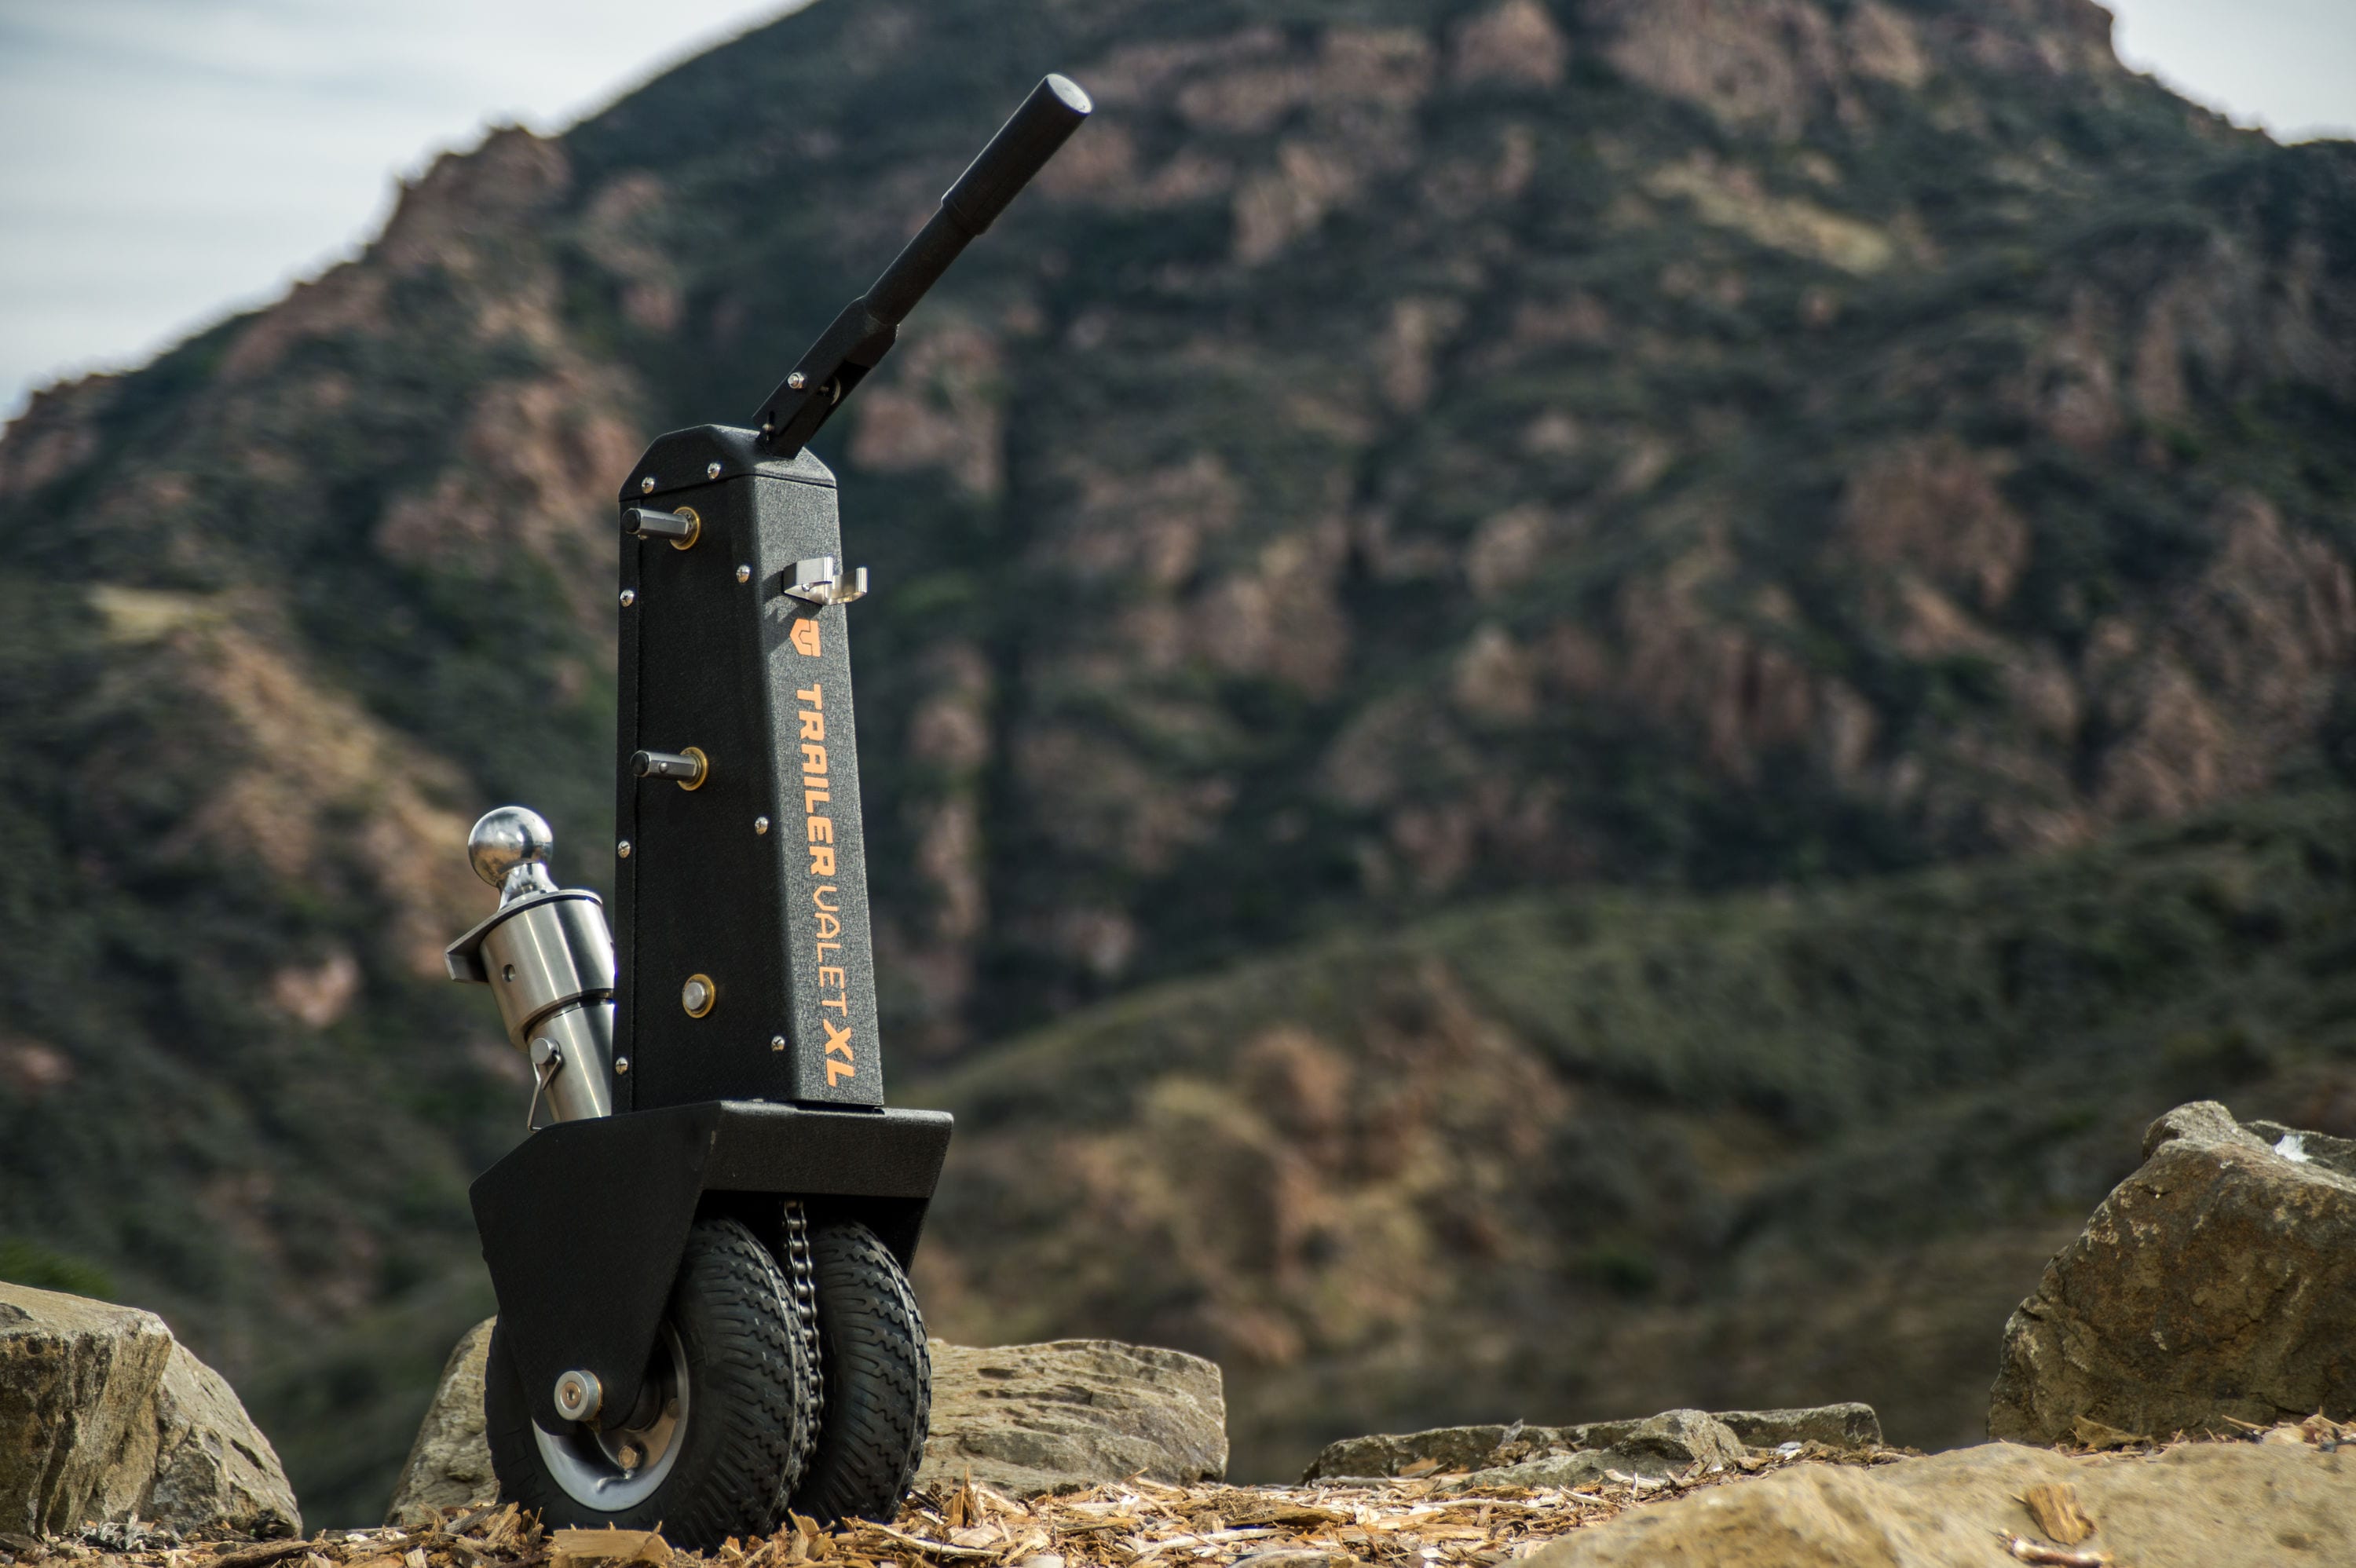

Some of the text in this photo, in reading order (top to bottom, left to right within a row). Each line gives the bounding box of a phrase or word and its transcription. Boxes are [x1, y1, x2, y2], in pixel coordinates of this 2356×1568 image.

[796, 684, 856, 1087] TRAILER VALET XL
